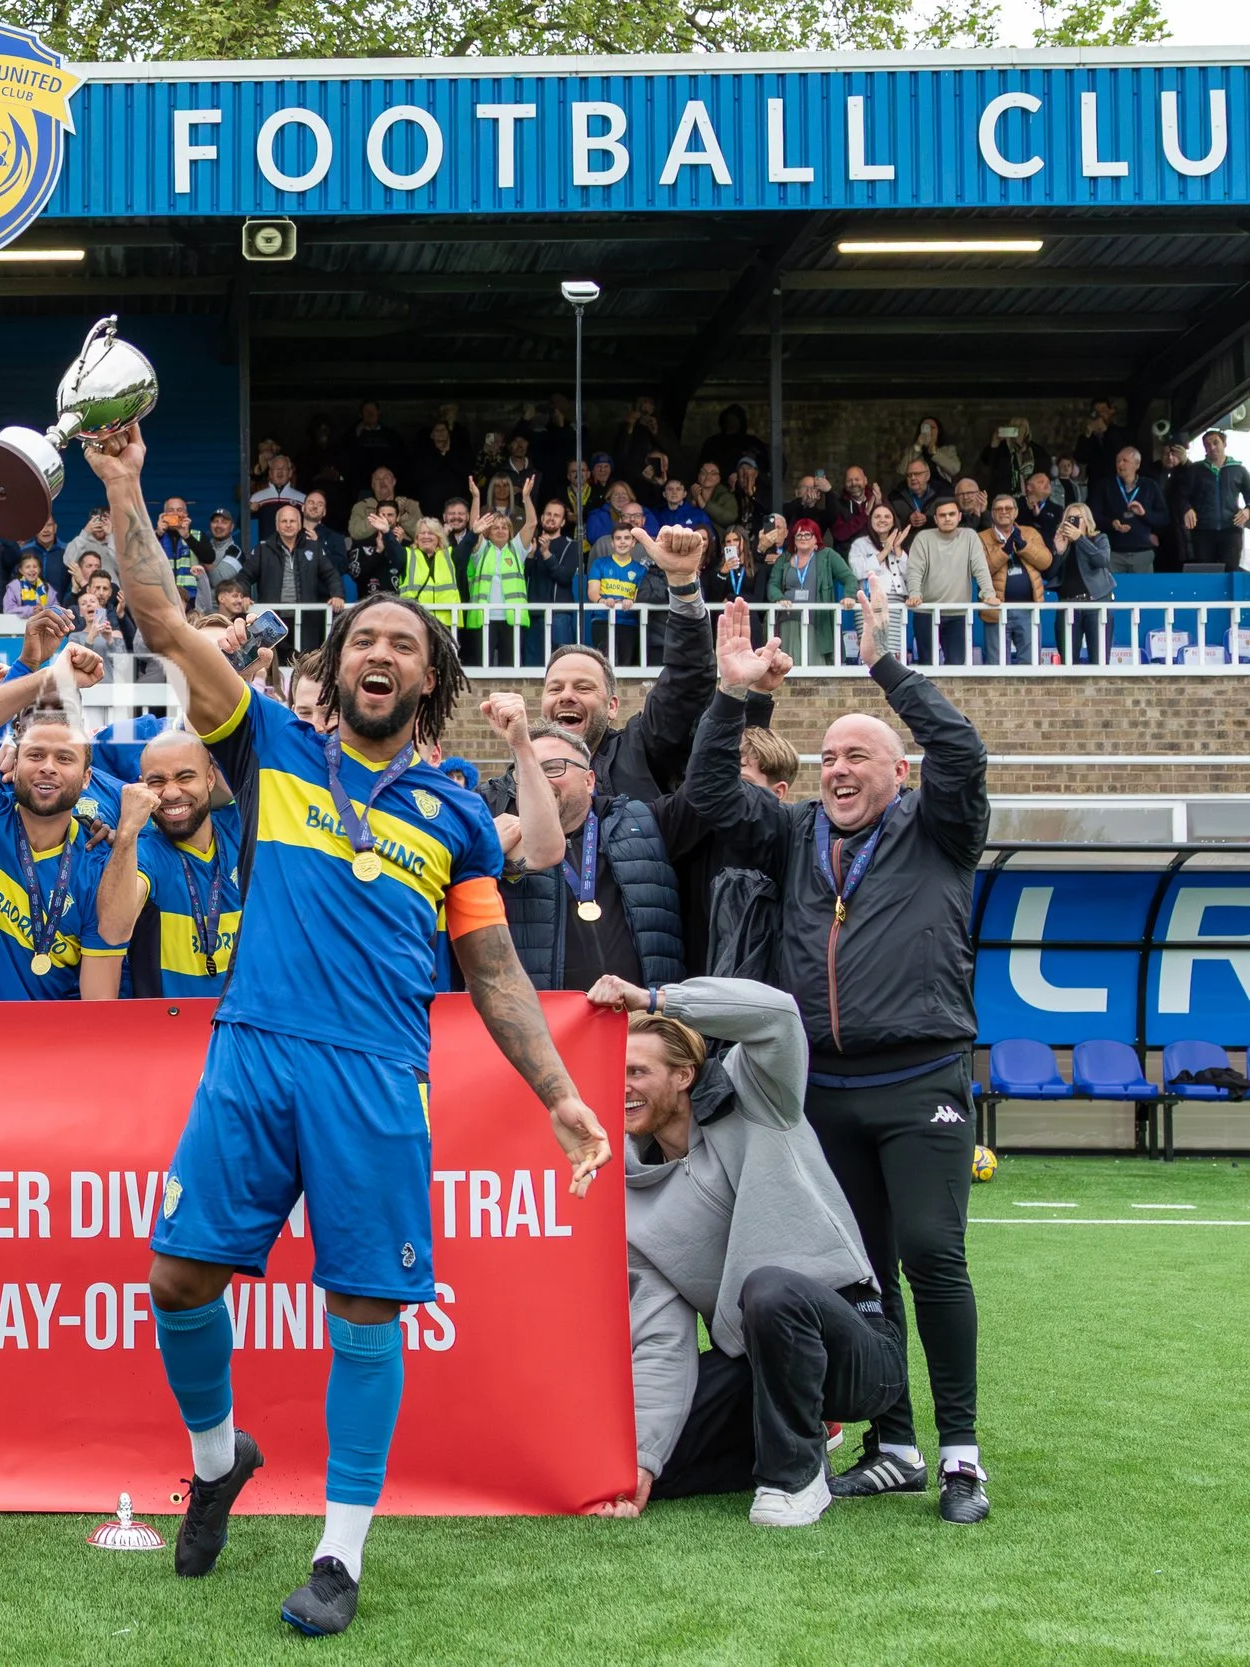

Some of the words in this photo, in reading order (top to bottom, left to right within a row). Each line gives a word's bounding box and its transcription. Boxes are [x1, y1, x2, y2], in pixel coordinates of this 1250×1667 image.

[1, 86, 34, 102] CLUB
[173, 95, 896, 195] FOOTBALL
[977, 89, 1228, 180] CLU
[433, 1169, 573, 1238] TRAL
